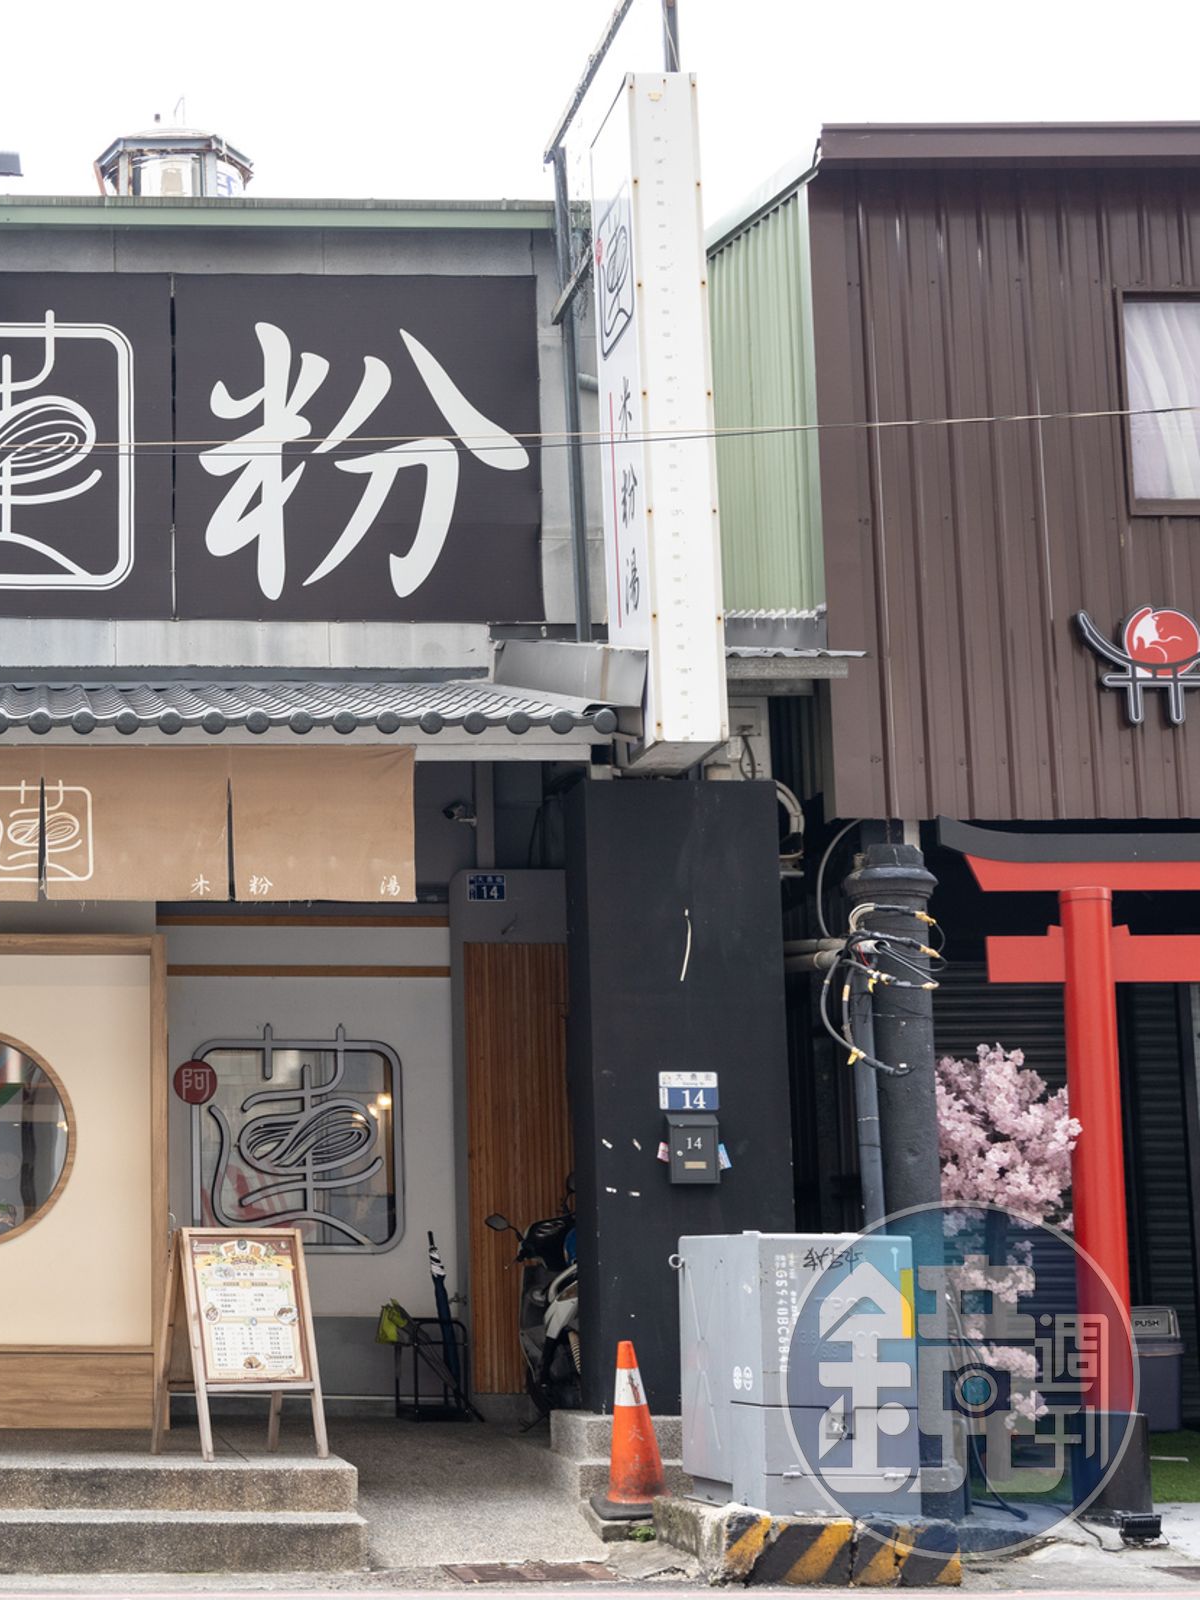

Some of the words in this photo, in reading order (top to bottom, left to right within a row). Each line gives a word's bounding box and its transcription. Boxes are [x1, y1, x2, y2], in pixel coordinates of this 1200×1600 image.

[199, 322, 530, 600] 粉
[618, 376, 640, 616] 米粉湯
[380, 875, 401, 896] 湯
[481, 886, 498, 899] 14
[182, 1068, 212, 1102] 阿
[682, 1089, 706, 1109] 14
[687, 1137, 702, 1150] 14
[1135, 1320, 1159, 1328] PUSH
